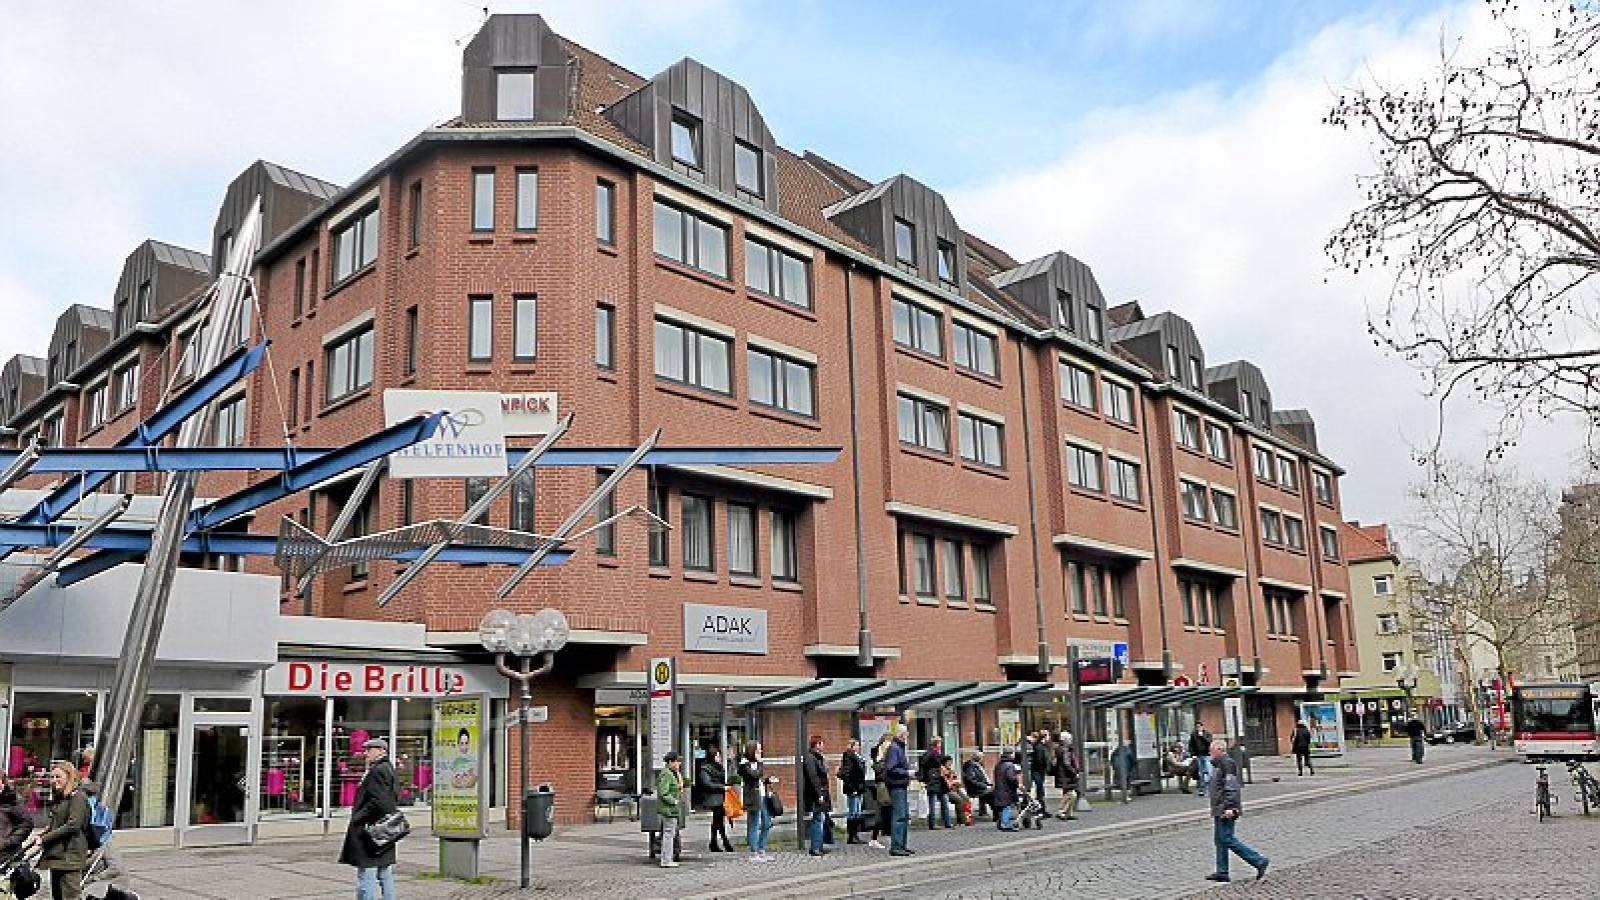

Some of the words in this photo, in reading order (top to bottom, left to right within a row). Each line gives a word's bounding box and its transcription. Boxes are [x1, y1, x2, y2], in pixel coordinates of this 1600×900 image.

[703, 615, 752, 635] ADAK
[288, 663, 352, 691] Die
[364, 665, 464, 693] Brille
